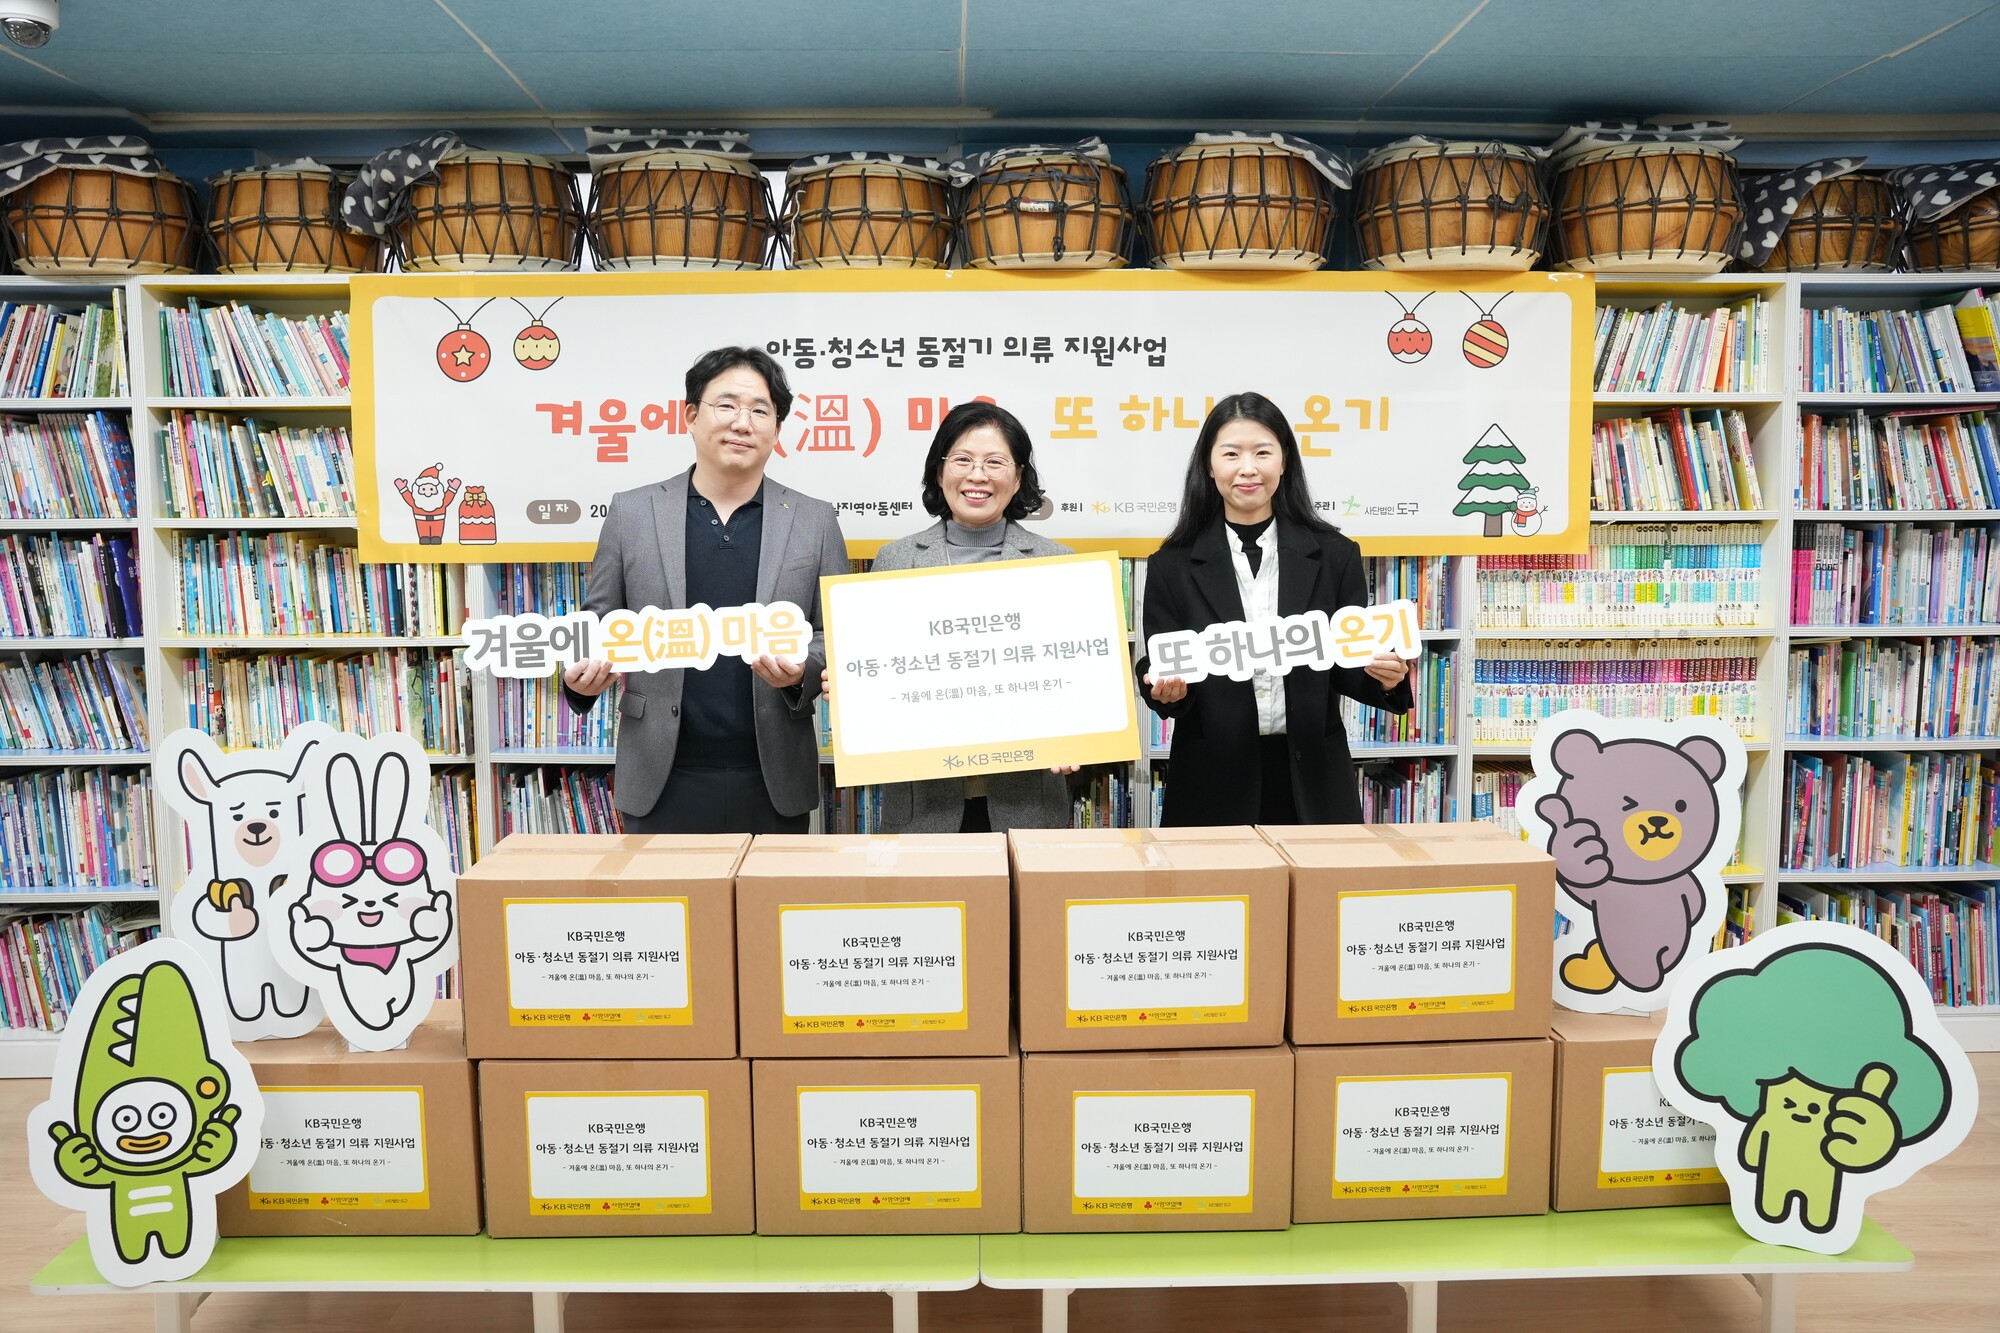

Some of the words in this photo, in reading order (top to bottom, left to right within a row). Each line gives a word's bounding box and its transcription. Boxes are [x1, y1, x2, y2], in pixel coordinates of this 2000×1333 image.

[766, 337, 904, 369] 아동·청소년
[917, 337, 992, 368] 동절기
[1003, 337, 1053, 363] 의류
[1065, 336, 1166, 367] 지원사업
[1050, 395, 1097, 439] 또
[1119, 394, 1213, 431] 하나
[1294, 394, 1390, 457] 온기
[1061, 502, 1078, 512] 후원
[1114, 502, 1135, 513] KB
[1136, 501, 1177, 513] 국민은행
[1314, 501, 1330, 510] 주관
[1364, 506, 1395, 515] 사단법인
[1397, 503, 1419, 515] 도구
[929, 613, 1020, 636] KB국민은행
[471, 621, 590, 668] 겨울에
[722, 611, 802, 654] 마음
[1158, 640, 1197, 676] 또
[1205, 620, 1324, 671] 하나의
[1335, 609, 1412, 657] 온기
[847, 653, 940, 677] 아동·청소년
[947, 648, 996, 669] 동절기
[1003, 645, 1036, 663] 의류
[1043, 638, 1108, 659] 지원사업
[901, 690, 931, 703] 겨울에
[967, 685, 990, 696] 마음,
[995, 684, 1004, 693] 또
[1008, 681, 1038, 693] 하나의
[1043, 678, 1062, 690] 온기
[968, 754, 988, 766] KB
[991, 750, 1034, 763] 국민은행
[1399, 920, 1454, 932] KB국민은행
[568, 931, 625, 942] KB국민은행
[843, 936, 900, 948] KB국민은행
[1128, 930, 1185, 942] KB국민은행
[1347, 943, 1403, 955] 아동·청소년
[1408, 941, 1437, 953] 동절기
[1442, 940, 1461, 950] 의류
[1466, 938, 1504, 949] 지원사업
[515, 952, 573, 963] 아동·청소년
[578, 952, 608, 963] 동절기
[613, 952, 633, 962] 의류
[638, 951, 679, 962] 지원사업
[1075, 952, 1132, 964] 아동·청소년
[1138, 951, 1167, 963] 동절기
[1172, 951, 1192, 961] 의류
[1197, 949, 1237, 960] 지원사업
[790, 959, 848, 970] 아동·청소년
[853, 958, 883, 969] 동절기
[888, 957, 909, 967] 의류
[914, 956, 954, 967] 지원사업
[1395, 1106, 1449, 1117] KB국민은행
[305, 1118, 361, 1129] KB국민은행
[589, 1123, 645, 1134] KB국민은행
[860, 1117, 916, 1128] KB국민은행
[1135, 1123, 1191, 1133] KB국민은행
[1610, 1117, 1663, 1129] 아동·청소년
[1343, 1127, 1398, 1138] 아동·청소년
[1403, 1126, 1432, 1137] 동절기
[1437, 1126, 1455, 1135] 의류
[1460, 1124, 1499, 1135] 지원사업
[315, 1138, 345, 1149] 동절기
[350, 1138, 370, 1148] 의류
[374, 1138, 414, 1148] 지원사업
[536, 1143, 594, 1154] 아동·청소년
[598, 1143, 628, 1154] 동절기
[633, 1143, 653, 1153] 의류
[658, 1143, 698, 1153] 지원사업
[807, 1138, 865, 1149] 아동·청소년
[870, 1138, 899, 1148] 동절기
[904, 1137, 924, 1147] 의류
[929, 1137, 969, 1147] 지원사업
[1081, 1143, 1139, 1153] 아동·청소년
[1144, 1143, 1173, 1153] 동절기
[1178, 1142, 1198, 1152] 의류
[1203, 1142, 1243, 1152] 지원사업
